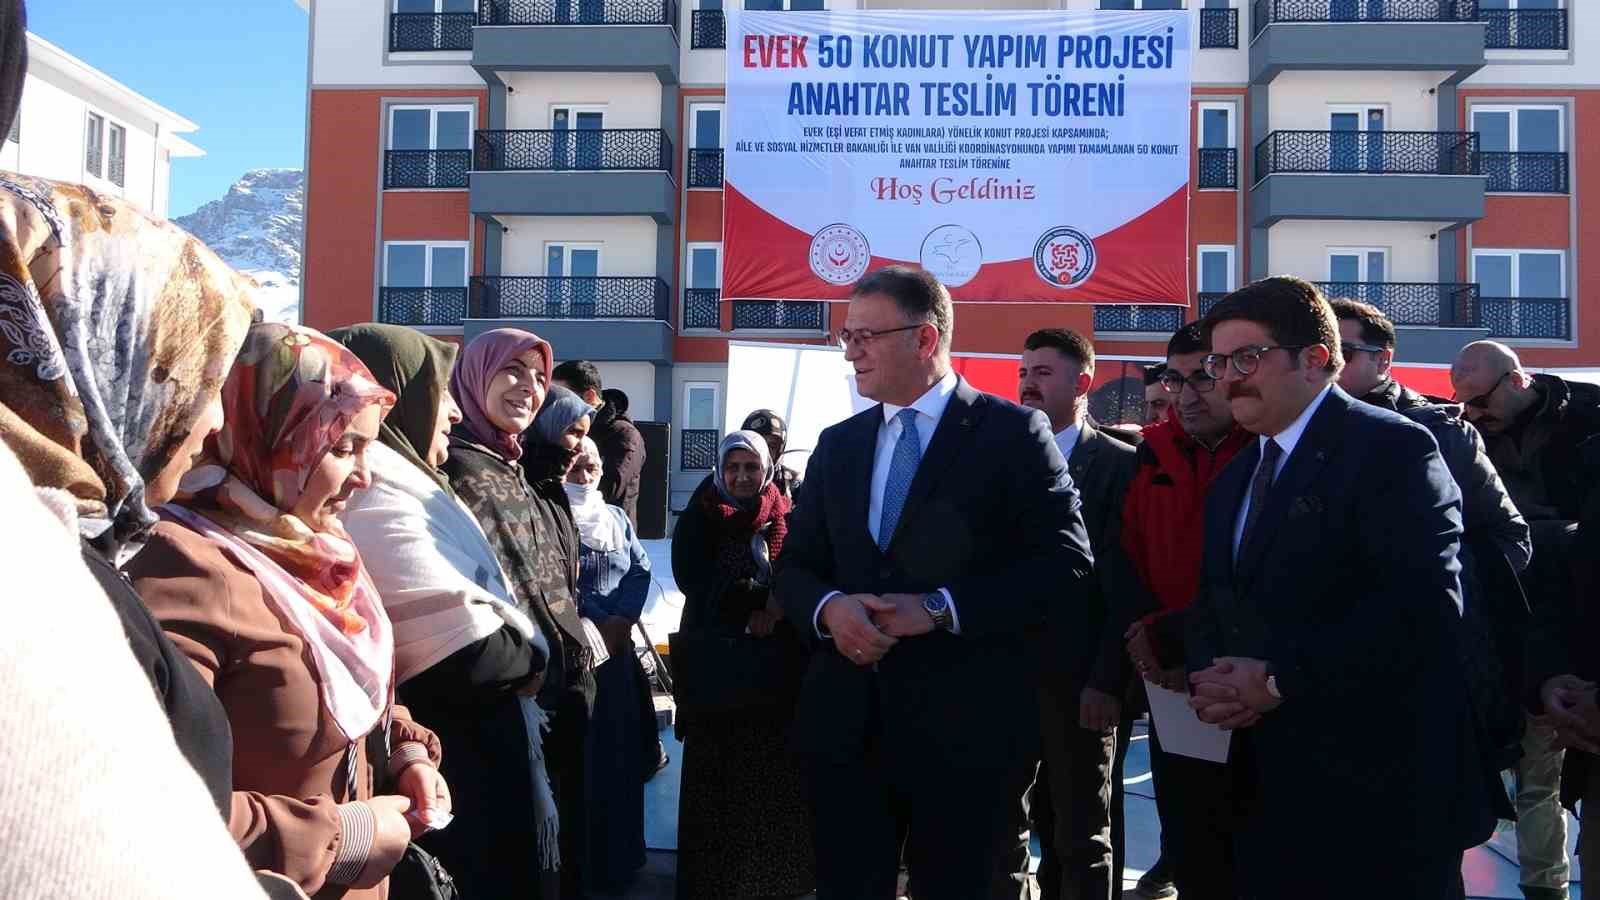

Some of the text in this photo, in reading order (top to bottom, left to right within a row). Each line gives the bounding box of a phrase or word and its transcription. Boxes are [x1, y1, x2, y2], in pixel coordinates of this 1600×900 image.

[743, 26, 1175, 69] EVEK 50 KONUT YAPIM PROJESİ
[787, 73, 1125, 117] ANAHTAR TESLİM TÖRENİ
[803, 124, 1110, 140] EVEK (EŞİ VEFAT ETMİŞ KADINLARA) YÖNELİK KONUT PROJESİ KAPSAMINDA;
[735, 139, 1179, 155] AİLE VE SOSYAL HİZMETLER BAKANLIĞI İLE VAN VALİLİĞİ KOORDİNASYONUNDA YAPIMI TAMAMLANAN 50 KONUT
[899, 155, 1012, 169] ANAHTAR TESLİM TÖRENİNE
[870, 176, 1036, 205] Hoş Geldiniz
